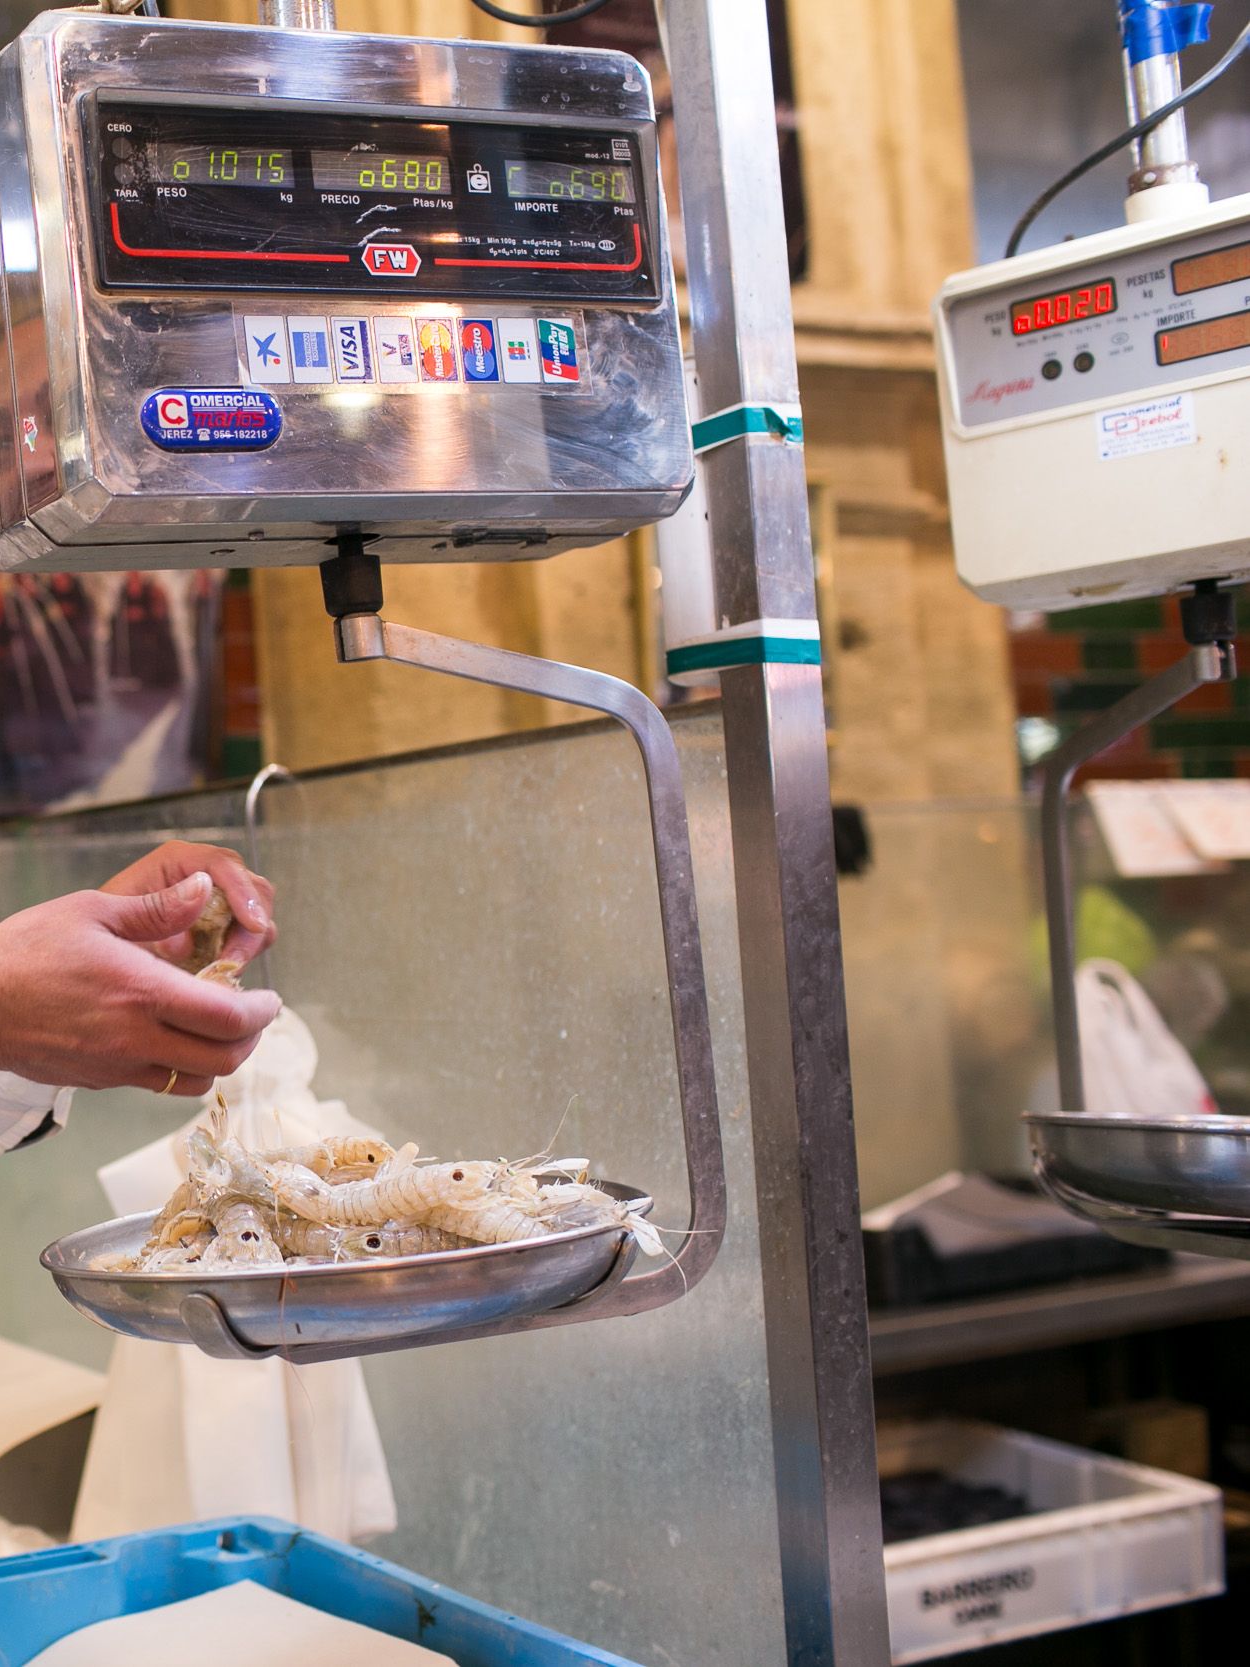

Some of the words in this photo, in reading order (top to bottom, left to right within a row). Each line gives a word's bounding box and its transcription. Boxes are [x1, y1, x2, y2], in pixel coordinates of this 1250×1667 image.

[107, 123, 132, 133] CERO
[114, 188, 139, 199] TARA
[156, 187, 187, 199] PESO
[280, 192, 293, 204] kg
[320, 194, 360, 205] PRECIO
[514, 201, 559, 213] IMPORTE
[613, 206, 634, 217] Ptas
[373, 249, 408, 270] FW
[1126, 268, 1167, 288] PESETAS
[1157, 308, 1196, 327] IMPORTE
[340, 325, 359, 371] VISA
[472, 327, 486, 373] Maestro
[548, 324, 563, 375] UnionPay
[160, 429, 193, 440] JEREZ
